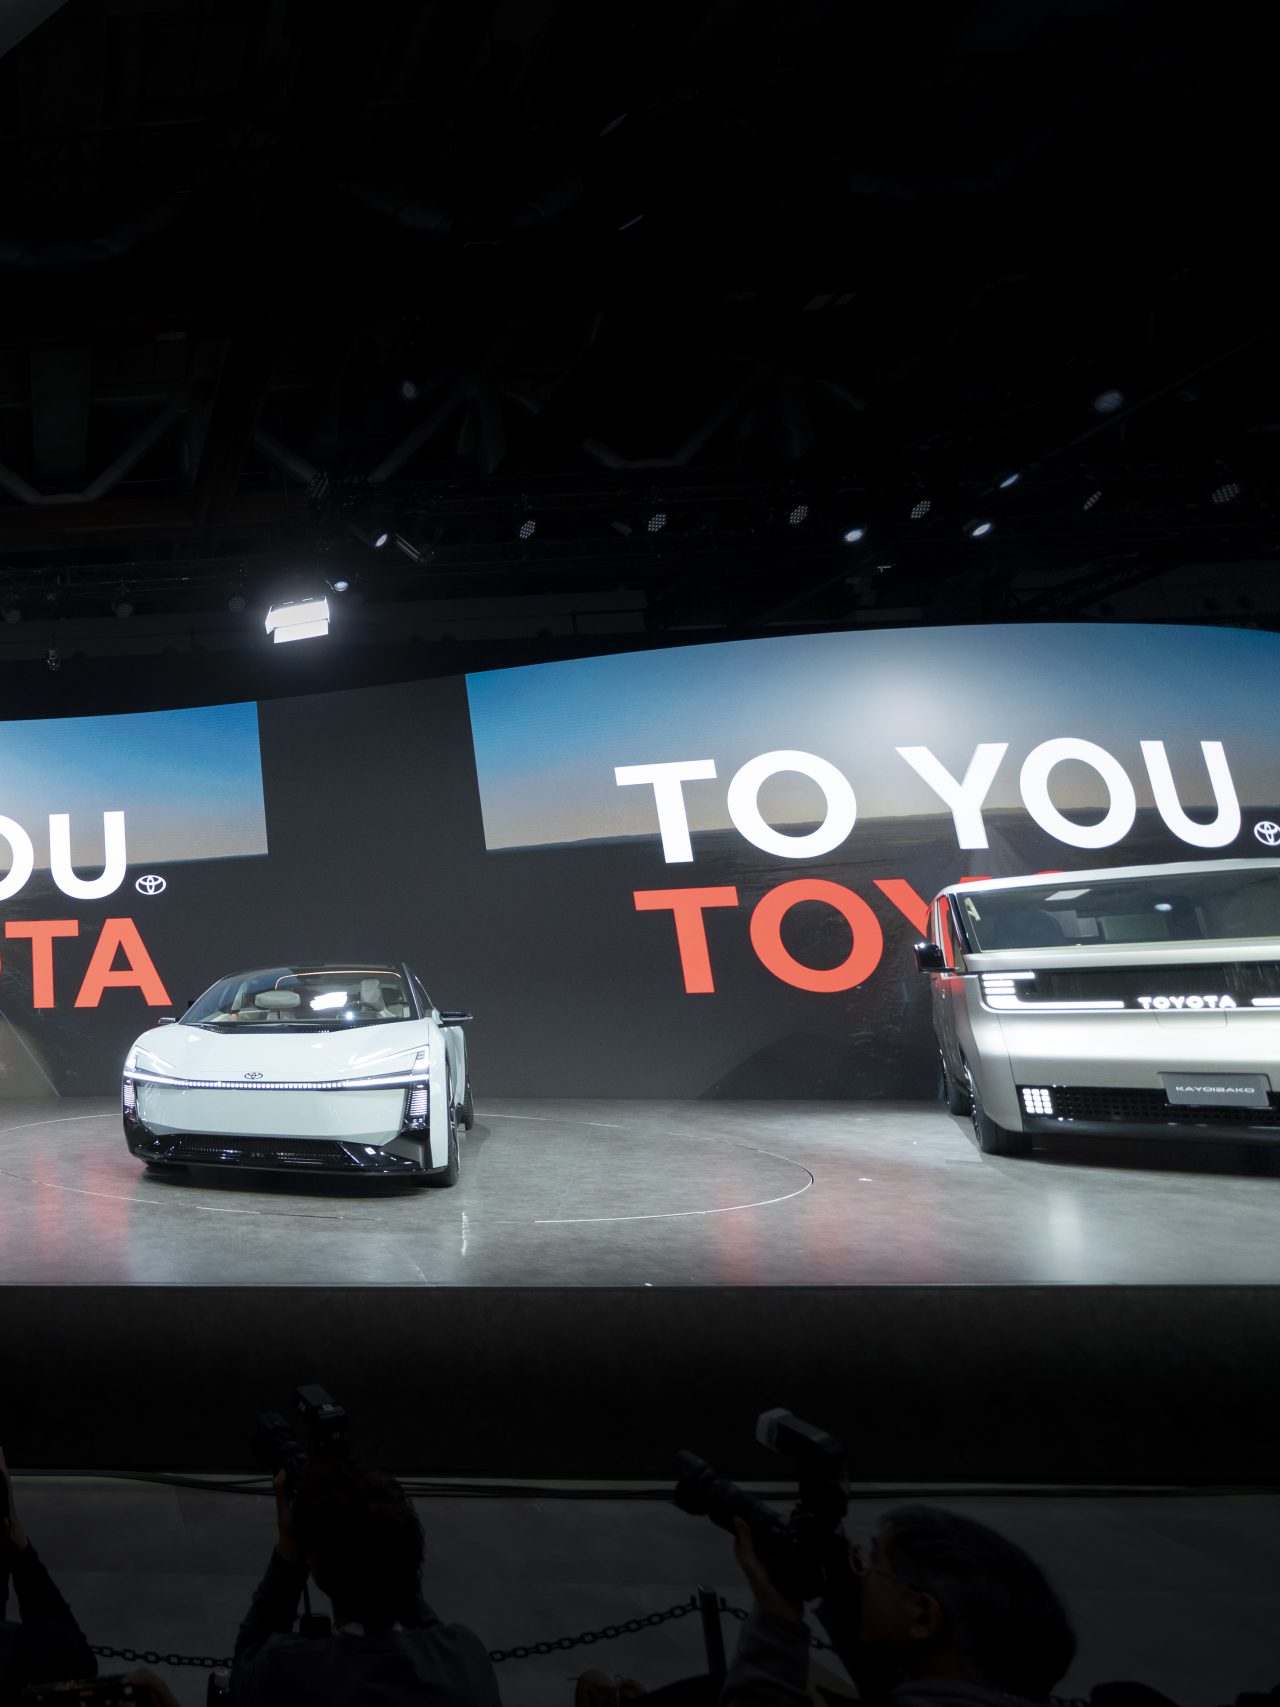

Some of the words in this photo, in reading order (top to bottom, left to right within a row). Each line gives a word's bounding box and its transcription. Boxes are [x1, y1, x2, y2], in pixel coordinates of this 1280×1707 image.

[614, 750, 857, 864] TO
[895, 738, 1241, 850] YOU
[1137, 994, 1237, 1009] TOYOTA
